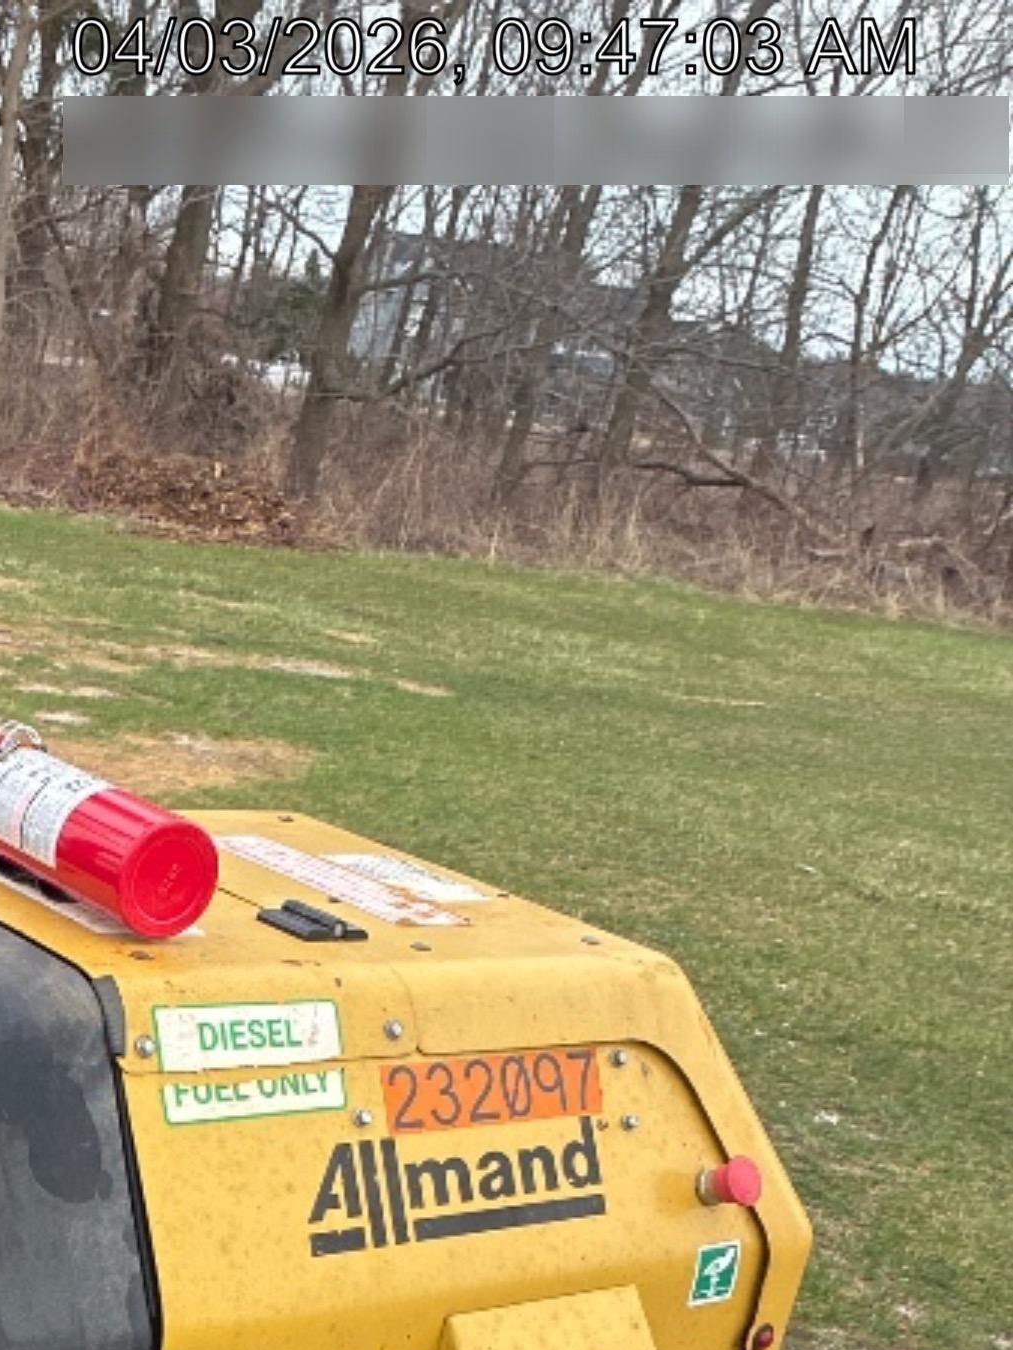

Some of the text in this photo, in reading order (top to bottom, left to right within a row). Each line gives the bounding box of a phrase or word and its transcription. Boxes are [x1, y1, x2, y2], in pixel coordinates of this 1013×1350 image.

[198, 1018, 303, 1051] DIESEL
[174, 1071, 328, 1107] FUEL ONLY
[388, 1050, 597, 1130] 232097
[308, 1115, 603, 1249] Allmand
